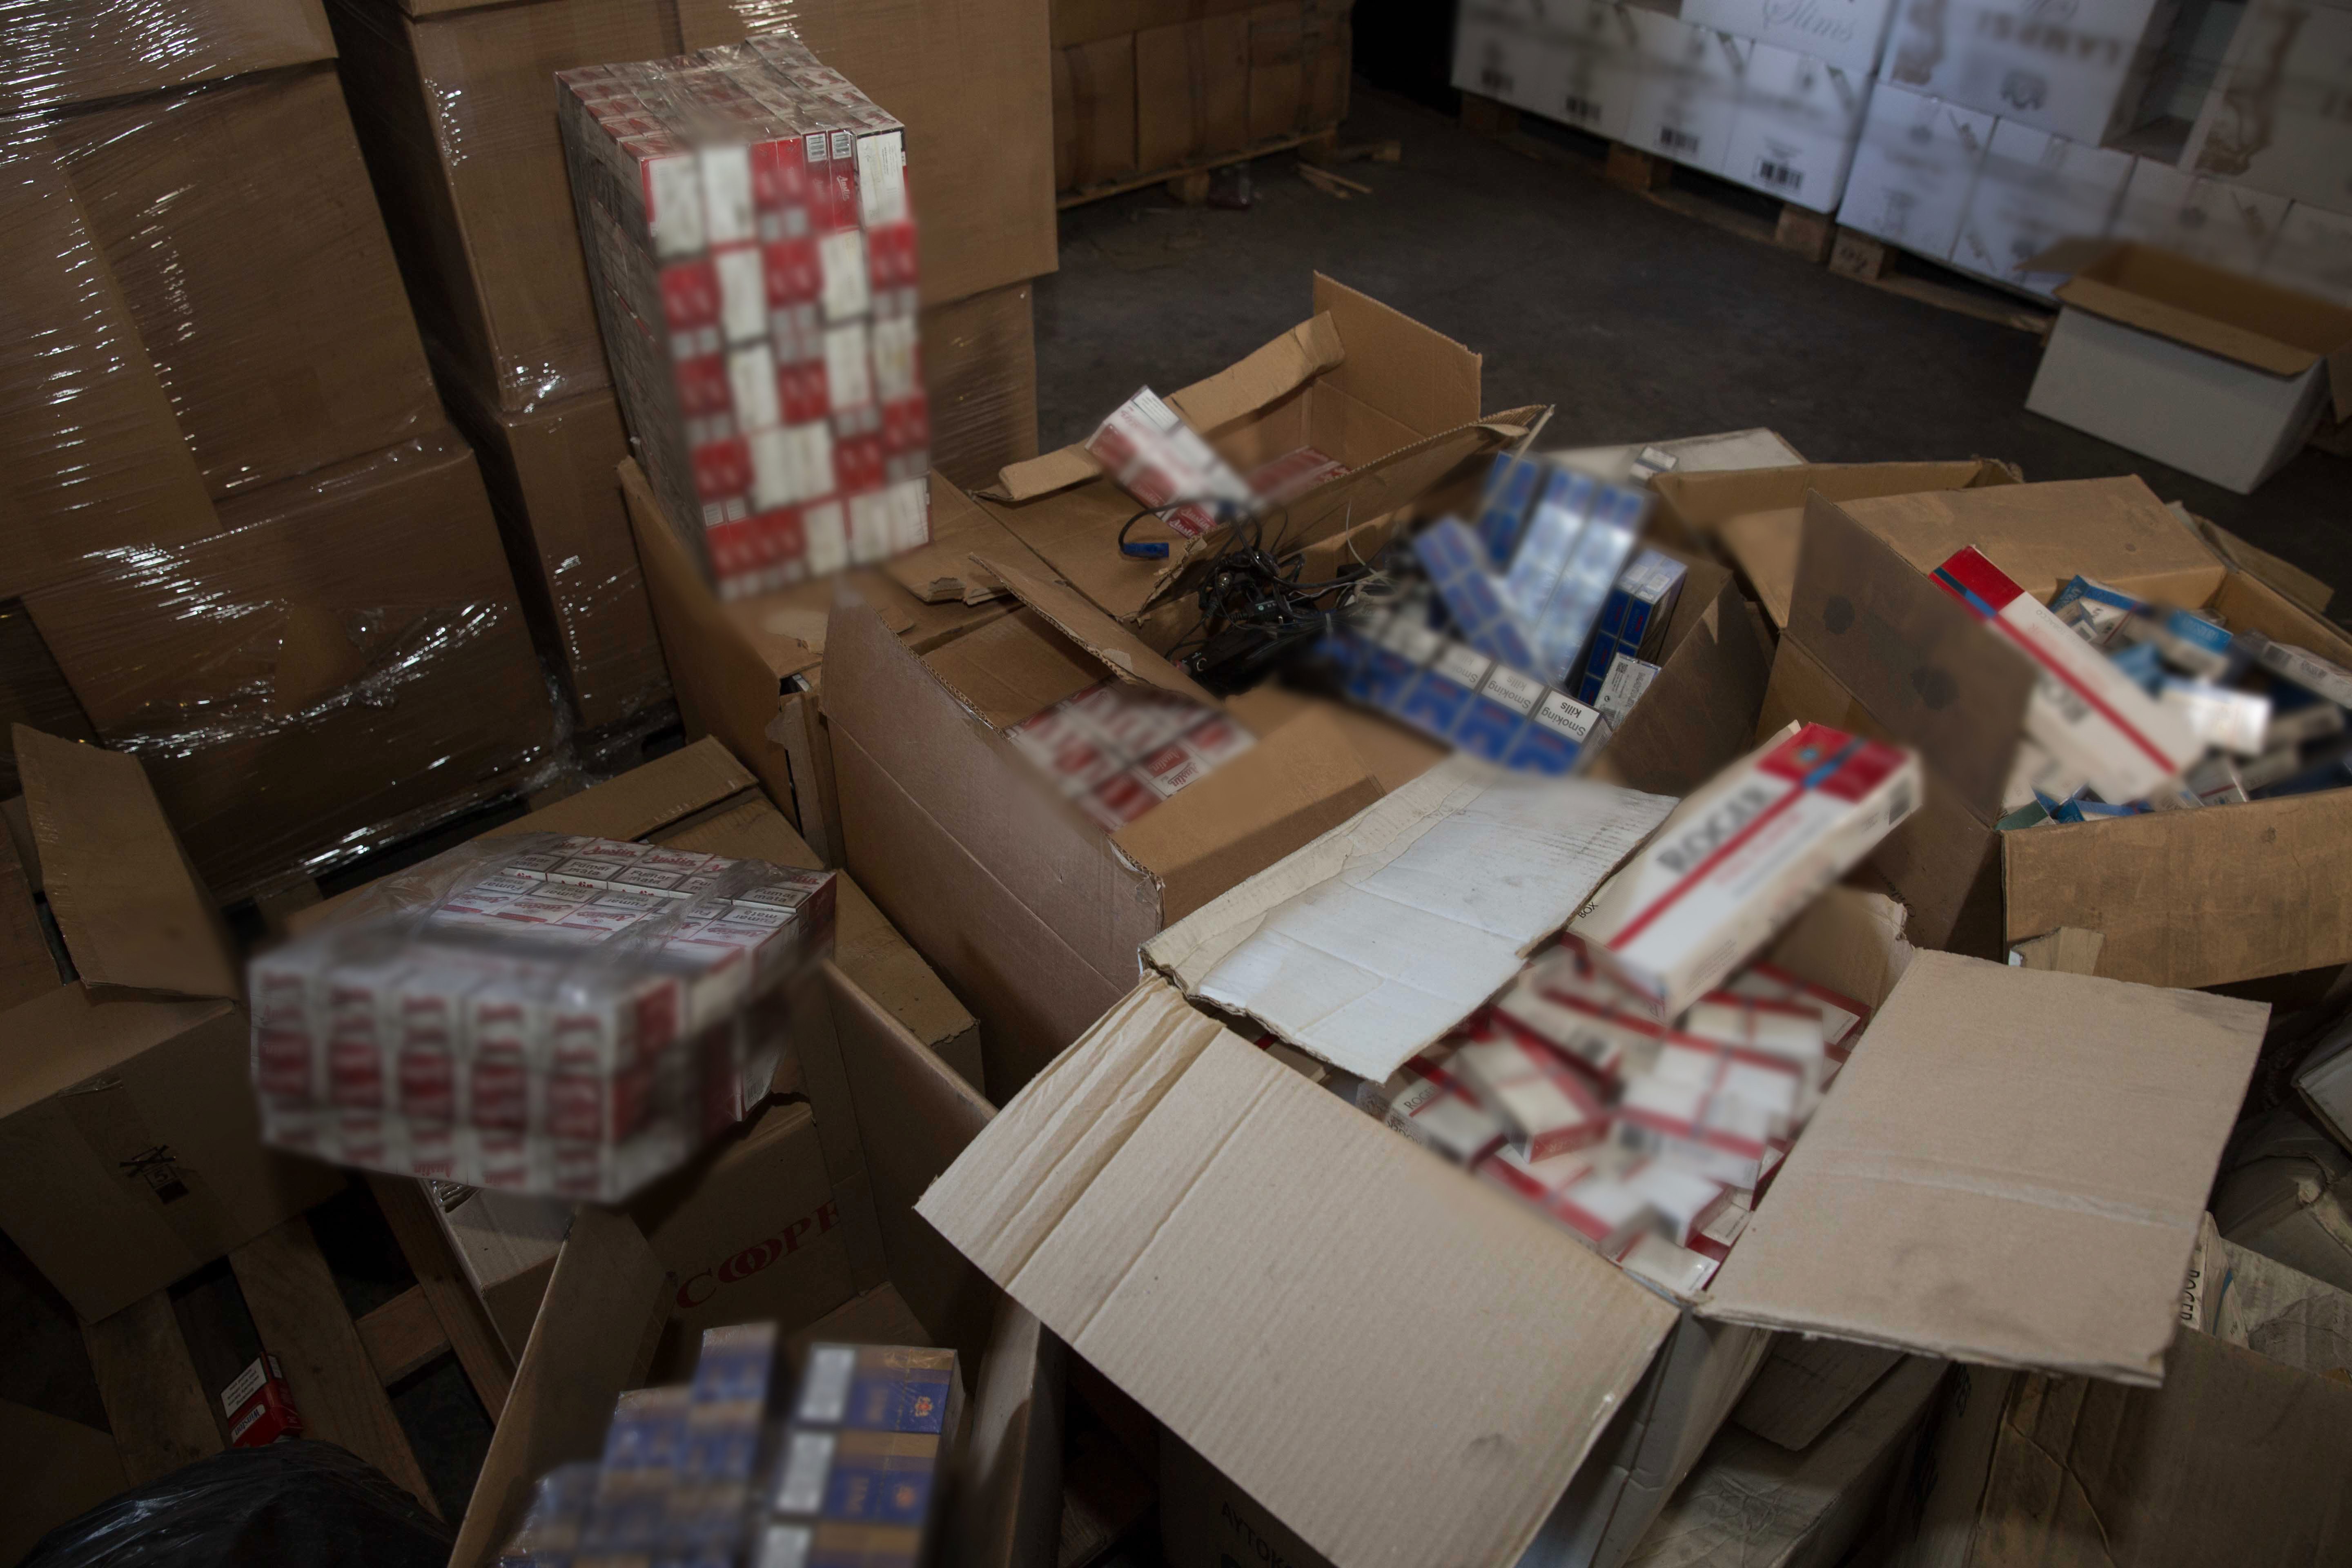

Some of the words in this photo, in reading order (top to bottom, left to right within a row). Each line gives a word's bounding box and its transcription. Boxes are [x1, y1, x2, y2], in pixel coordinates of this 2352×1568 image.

[837, 175, 851, 201] Austin
[1506, 675, 1527, 692] kills
[1487, 680, 1531, 709] Smoking
[1560, 702, 1582, 718] kills
[1541, 706, 1586, 736] Smoking
[582, 846, 637, 857] Austin
[643, 855, 697, 866] Austin
[568, 867, 600, 876] mata
[572, 861, 610, 872] Fumar
[629, 876, 662, 885] mata
[630, 870, 672, 880] Fumar
[483, 881, 523, 891] Fumar
[544, 889, 586, 899] Fumar
[753, 894, 788, 903] mata
[755, 888, 798, 899] Fumar
[606, 898, 648, 908] Fumar
[744, 910, 778, 919] mata
[1577, 901, 1599, 919] BOX
[735, 915, 776, 924] Fumar
[1403, 1086, 1438, 1110] ROGER
[234, 1408, 260, 1436] Winston
